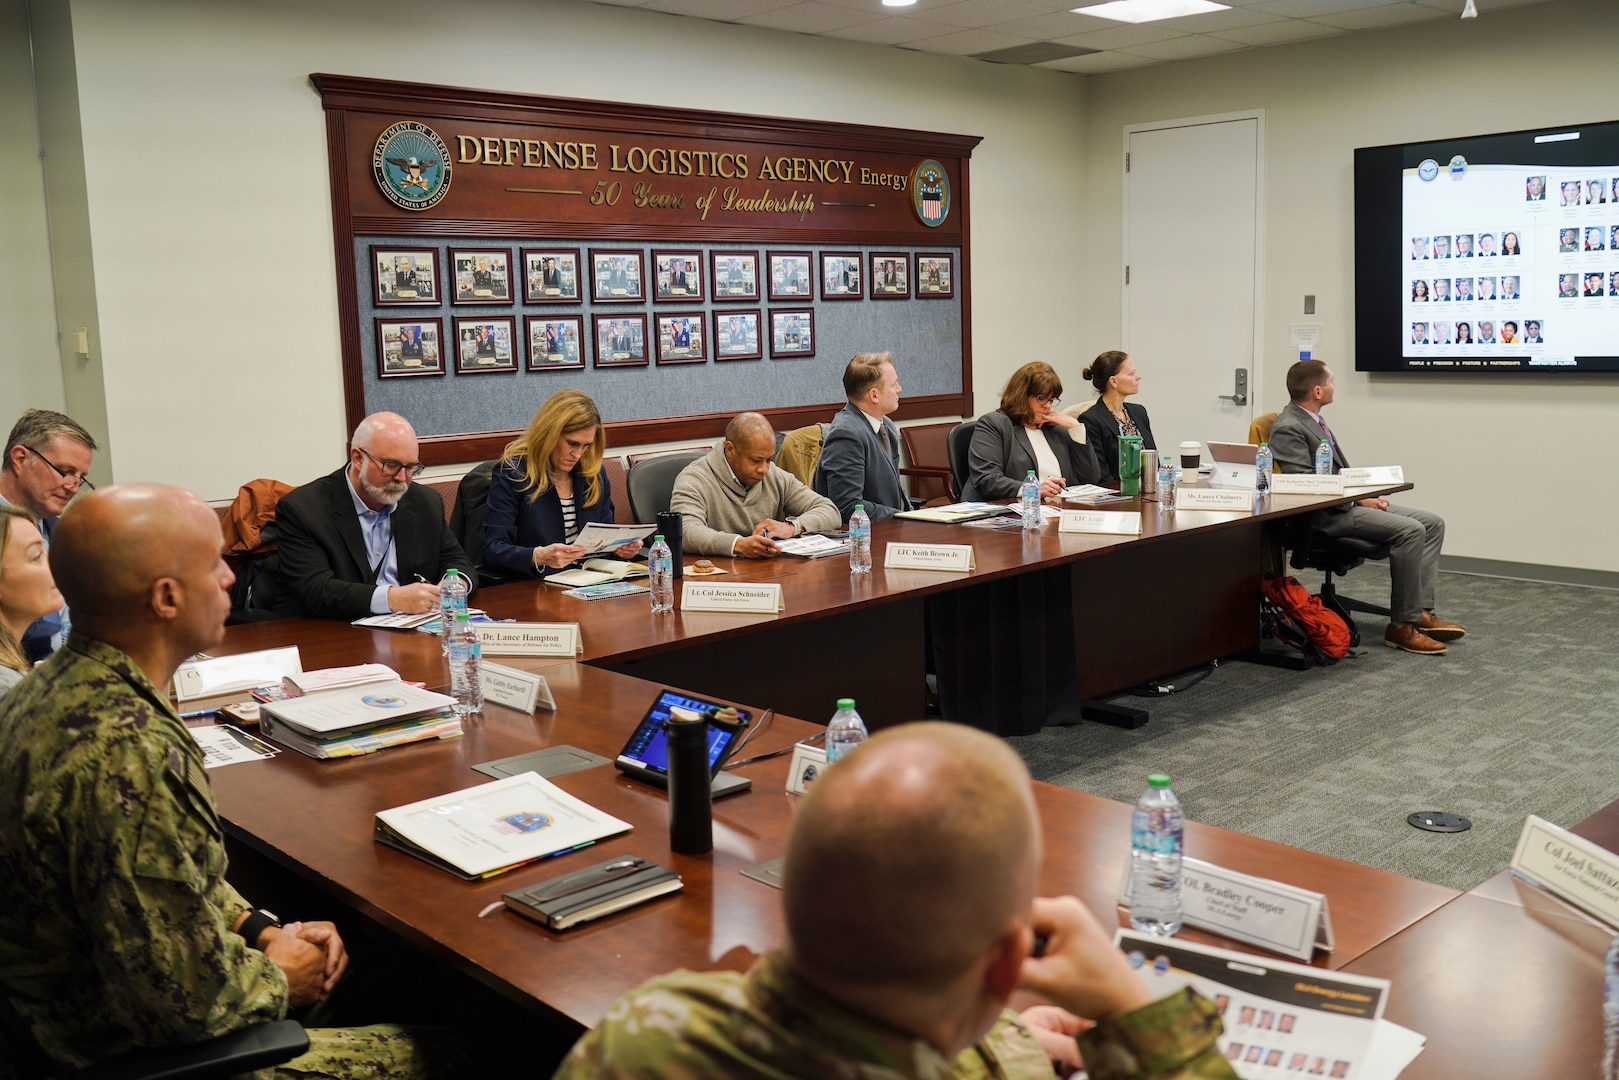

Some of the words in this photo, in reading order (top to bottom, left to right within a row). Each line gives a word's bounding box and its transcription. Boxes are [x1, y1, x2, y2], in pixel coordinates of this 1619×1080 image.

[376, 123, 410, 168] DEPARTMENT
[416, 124, 427, 132] OF
[430, 130, 450, 170] DEFENSE
[456, 134, 598, 170] DEFENSE
[610, 144, 749, 178] LOGISTICS
[758, 156, 854, 184] AGENCY
[860, 168, 908, 190] Energy
[382, 180, 398, 200] UNITED
[398, 198, 420, 208] STATES
[429, 183, 448, 204] AMERICA
[590, 181, 622, 206] 50
[633, 182, 686, 208] Years
[696, 186, 716, 220] of
[720, 186, 816, 222] Leadership
[522, 634, 559, 643] Hampton
[1544, 841, 1563, 859] Col
[1563, 851, 1586, 870] Joel
[1184, 877, 1200, 890] OL
[1203, 882, 1242, 904] Bradley
[1245, 895, 1285, 914] Cooper
